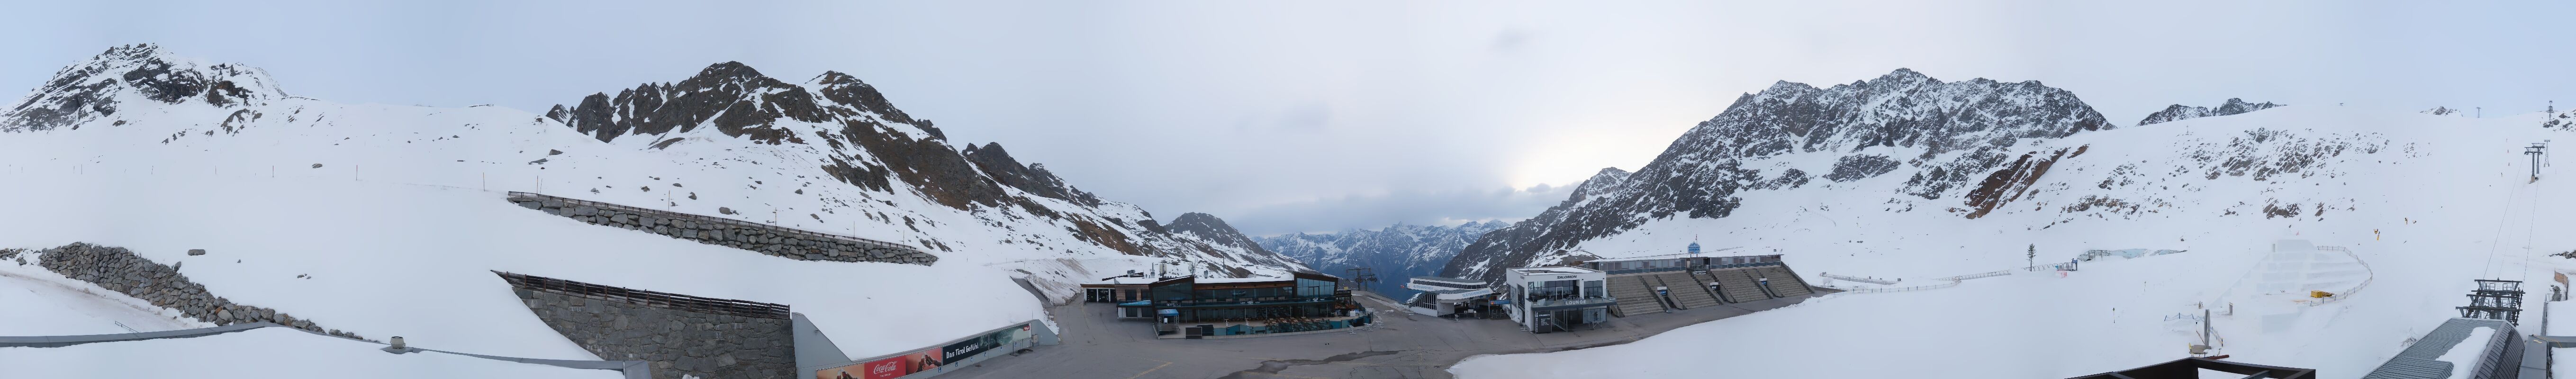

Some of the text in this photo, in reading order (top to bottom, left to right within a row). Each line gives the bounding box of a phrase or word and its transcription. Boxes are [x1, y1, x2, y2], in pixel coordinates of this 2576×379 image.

[955, 346, 966, 356] Tirol
[966, 343, 979, 352] Gefühl
[873, 361, 897, 375] Coca-Cola
